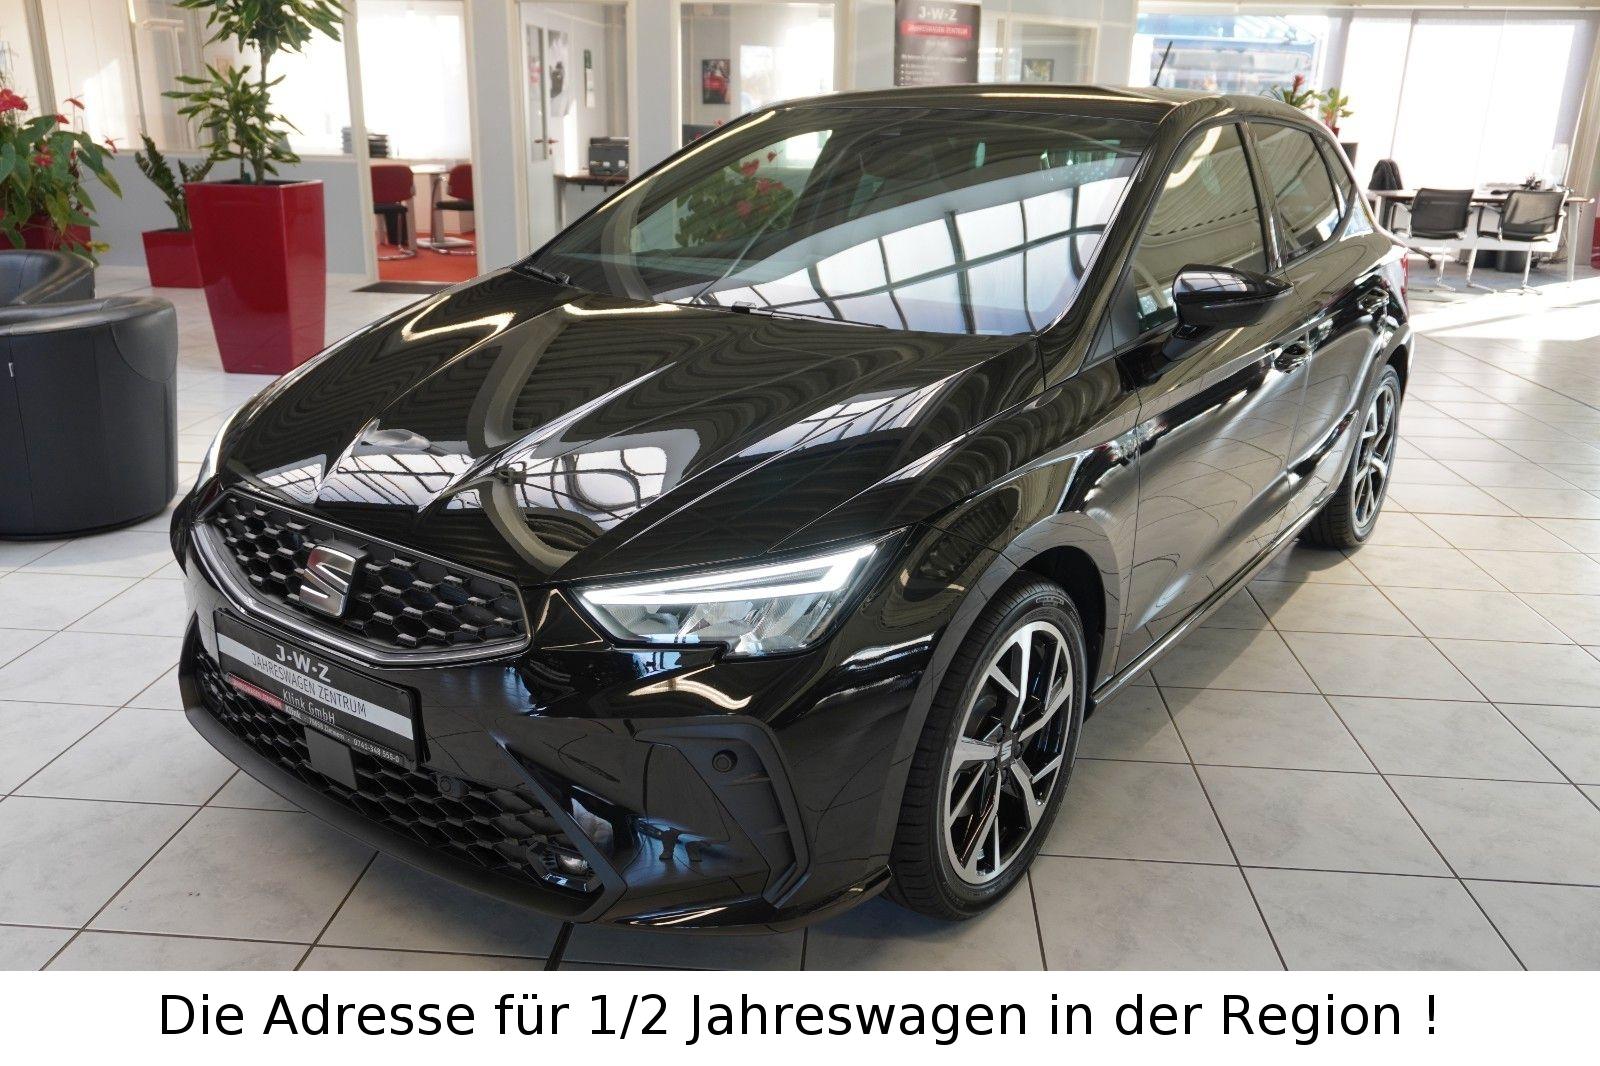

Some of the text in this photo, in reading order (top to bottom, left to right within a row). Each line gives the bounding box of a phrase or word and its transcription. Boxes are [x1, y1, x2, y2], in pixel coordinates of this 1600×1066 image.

[251, 652, 316, 696] JAHRESWAGEN
[318, 685, 367, 718] ZENTRUM
[282, 688, 306, 712] Klink
[308, 701, 336, 725] GmbH
